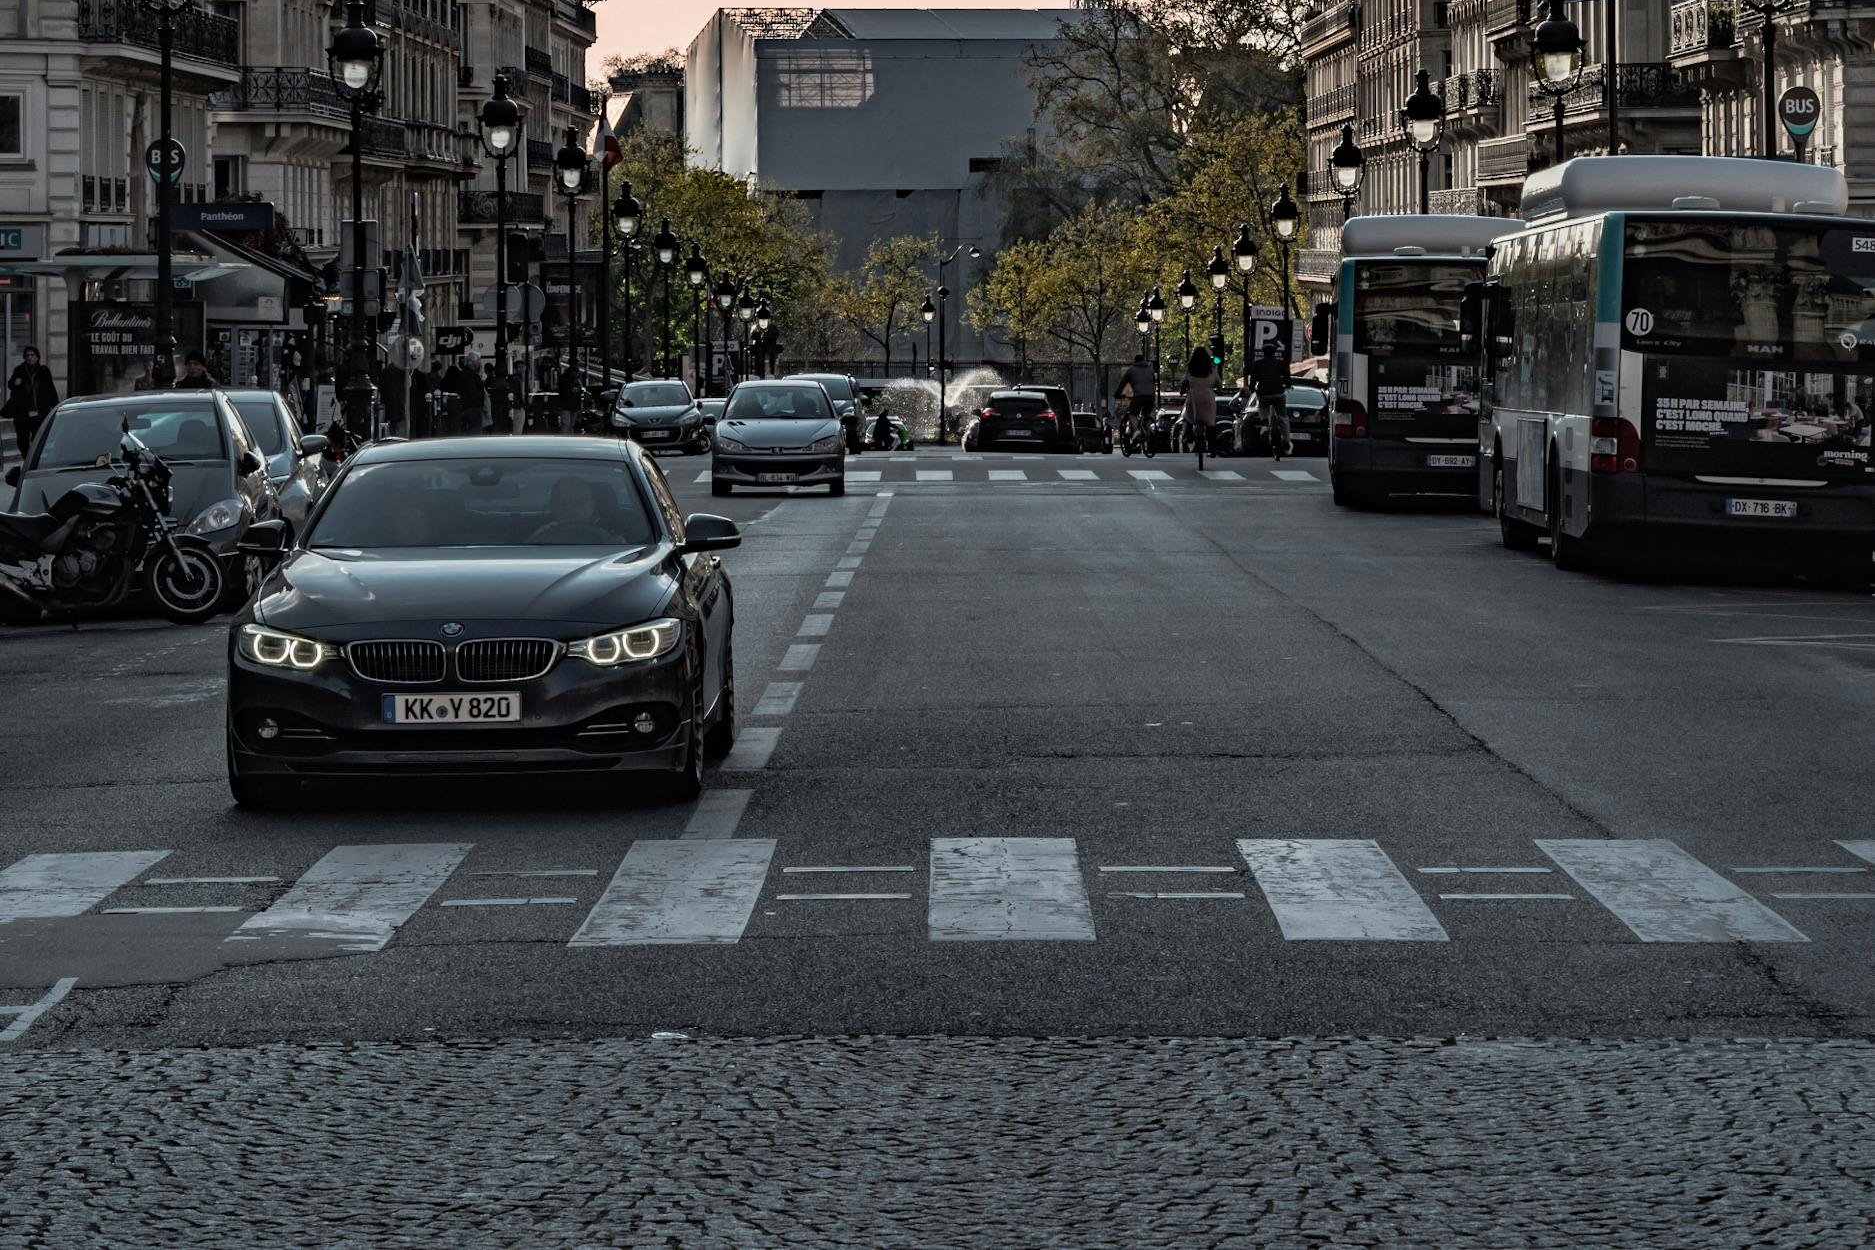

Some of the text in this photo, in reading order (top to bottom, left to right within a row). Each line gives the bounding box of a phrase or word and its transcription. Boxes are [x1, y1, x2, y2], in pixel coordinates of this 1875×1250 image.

[1785, 98, 1814, 114] BUS
[152, 151, 179, 164] BS
[201, 211, 244, 222] Panthéon
[1632, 312, 1649, 332] 70
[91, 333, 102, 343] LE
[122, 333, 133, 343] DU
[1255, 320, 1278, 350] P
[91, 345, 155, 355] TRAVAIL BIEN FAIT
[1747, 345, 1784, 354] MAN
[1657, 397, 1670, 408] 35
[1670, 398, 1679, 409] H
[1679, 398, 1700, 410] PAR
[1656, 409, 1748, 422] C'EST LONG QUAND
[1656, 419, 1684, 430] C'EST
[1824, 450, 1869, 463] morning
[405, 697, 510, 719] KK Y 820
